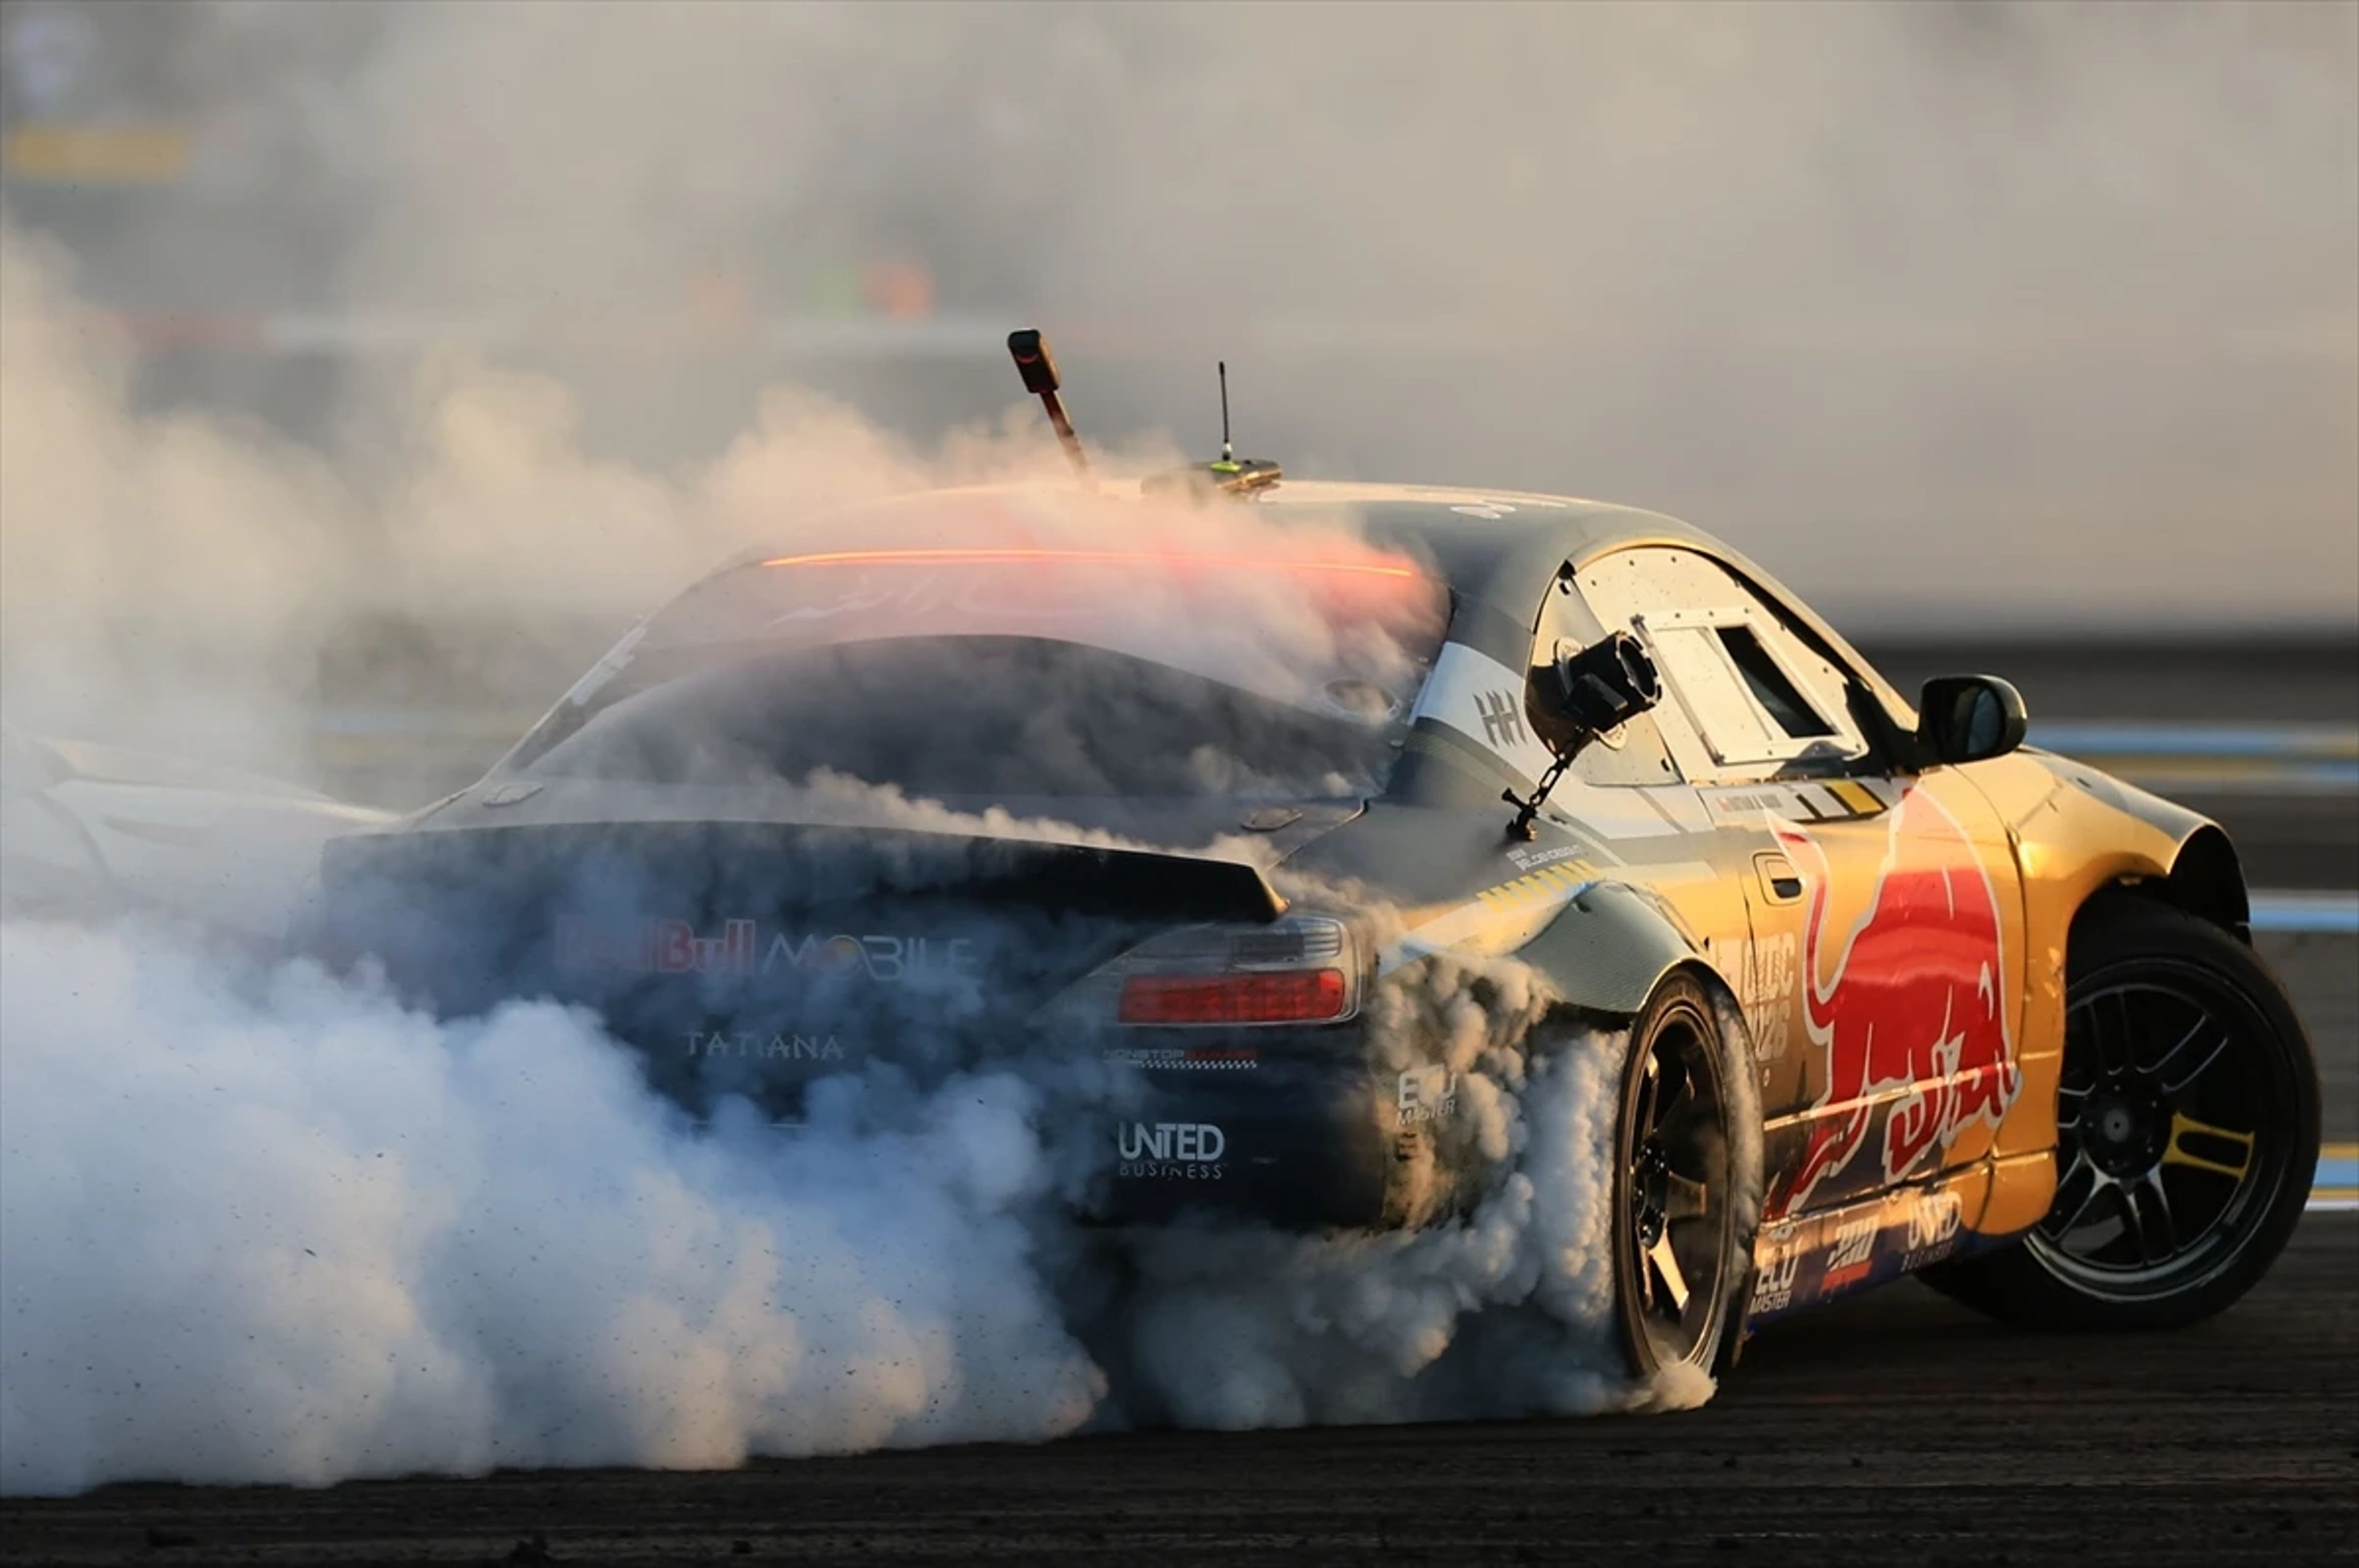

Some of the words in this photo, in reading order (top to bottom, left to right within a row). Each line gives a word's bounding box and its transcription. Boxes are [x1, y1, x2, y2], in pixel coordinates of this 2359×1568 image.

[761, 932, 978, 983] MOBILE
[681, 1031, 846, 1060] TATIANA
[1399, 1064, 1457, 1109] EU
[1119, 1122, 1225, 1161] UNITED
[1120, 1161, 1223, 1180] BUSINESS
[1755, 1235, 1805, 1296] ECU
[1748, 1290, 1792, 1315] MASTER
